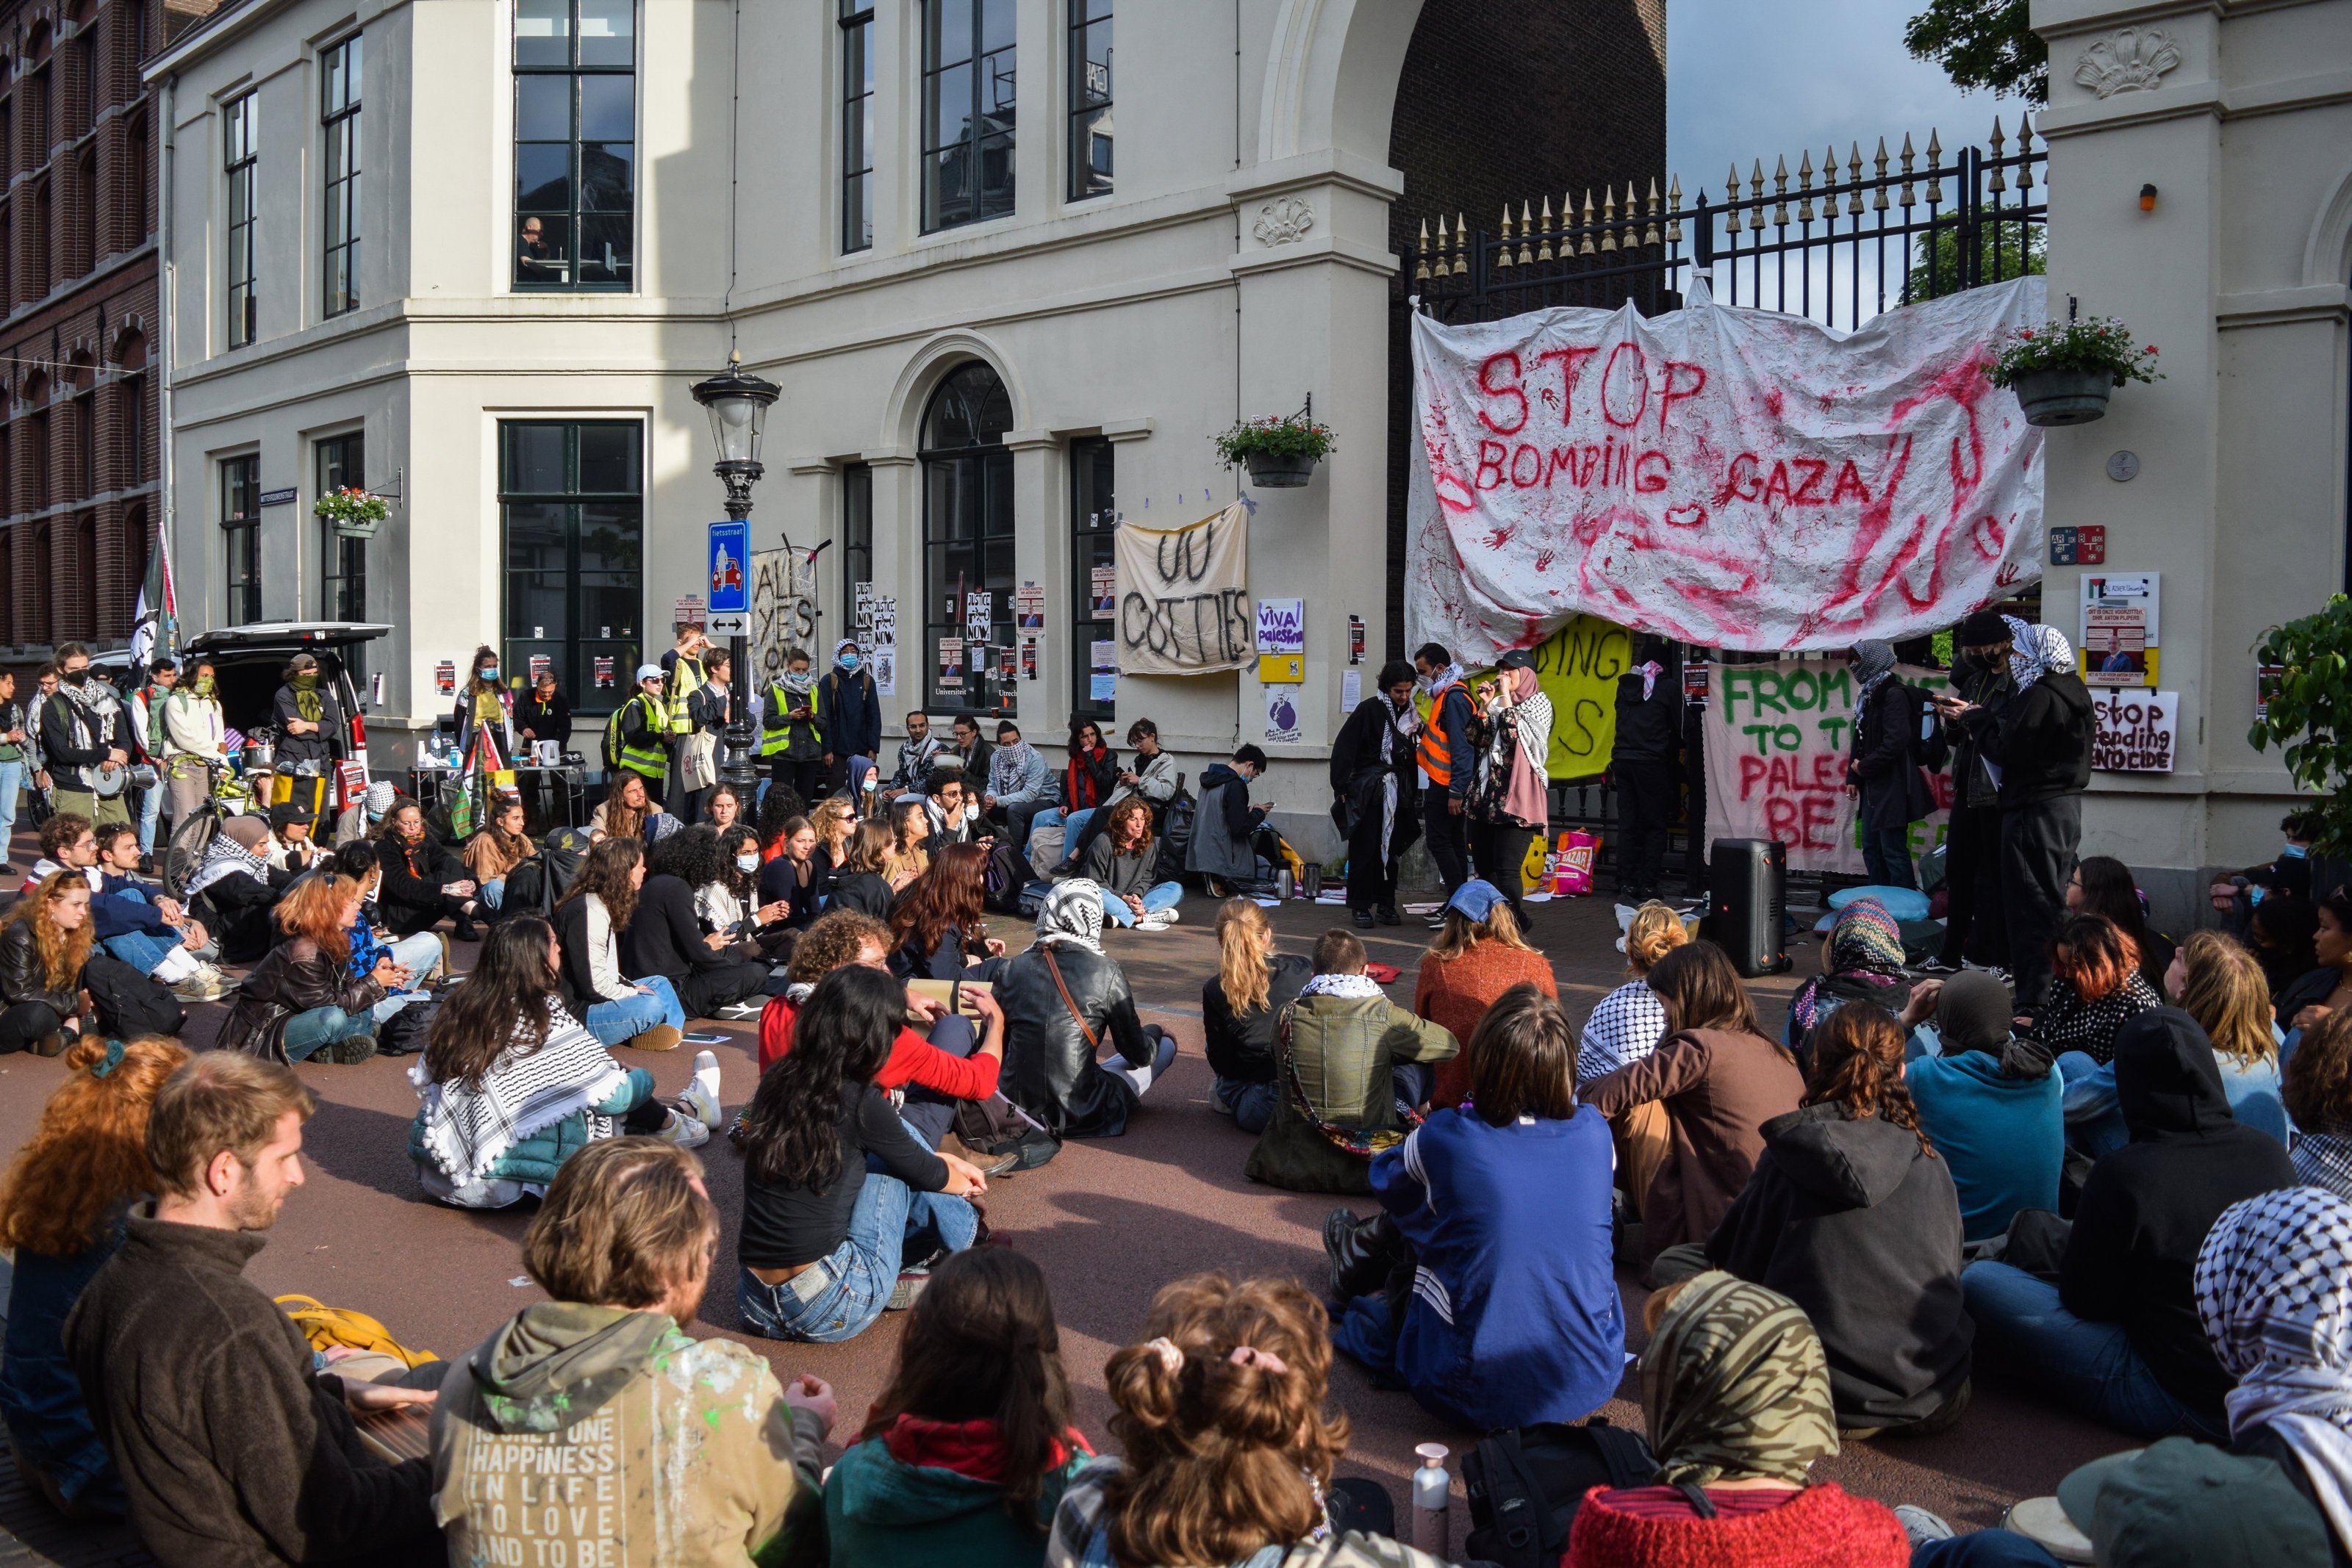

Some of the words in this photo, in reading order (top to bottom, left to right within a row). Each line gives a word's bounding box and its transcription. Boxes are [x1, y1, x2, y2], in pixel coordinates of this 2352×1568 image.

[1477, 342, 1707, 437] STOP
[1727, 452, 1871, 507] GAZA
[712, 528, 742, 536] fietsstraat
[2052, 534, 2064, 543] AR
[2079, 533, 2085, 543] B
[1157, 522, 1213, 582] UU
[755, 555, 804, 603] ALL
[875, 601, 894, 613] JUSTICE
[968, 594, 990, 605] JUSTICE
[875, 631, 894, 645] NOW
[968, 625, 989, 639] NOW
[1721, 667, 1851, 724] FROM
[1742, 723, 1801, 755] TO
[1764, 796, 1835, 849] BE
[1562, 850, 1587, 868] BAZAR
[1769, 898, 1778, 921] JBL
[568, 1417, 614, 1442] ONE
[473, 1503, 507, 1533] TO
[522, 1505, 614, 1536] LOVE
[475, 1533, 523, 1567] AND
[534, 1539, 567, 1568] TO
[578, 1539, 614, 1568] BE
